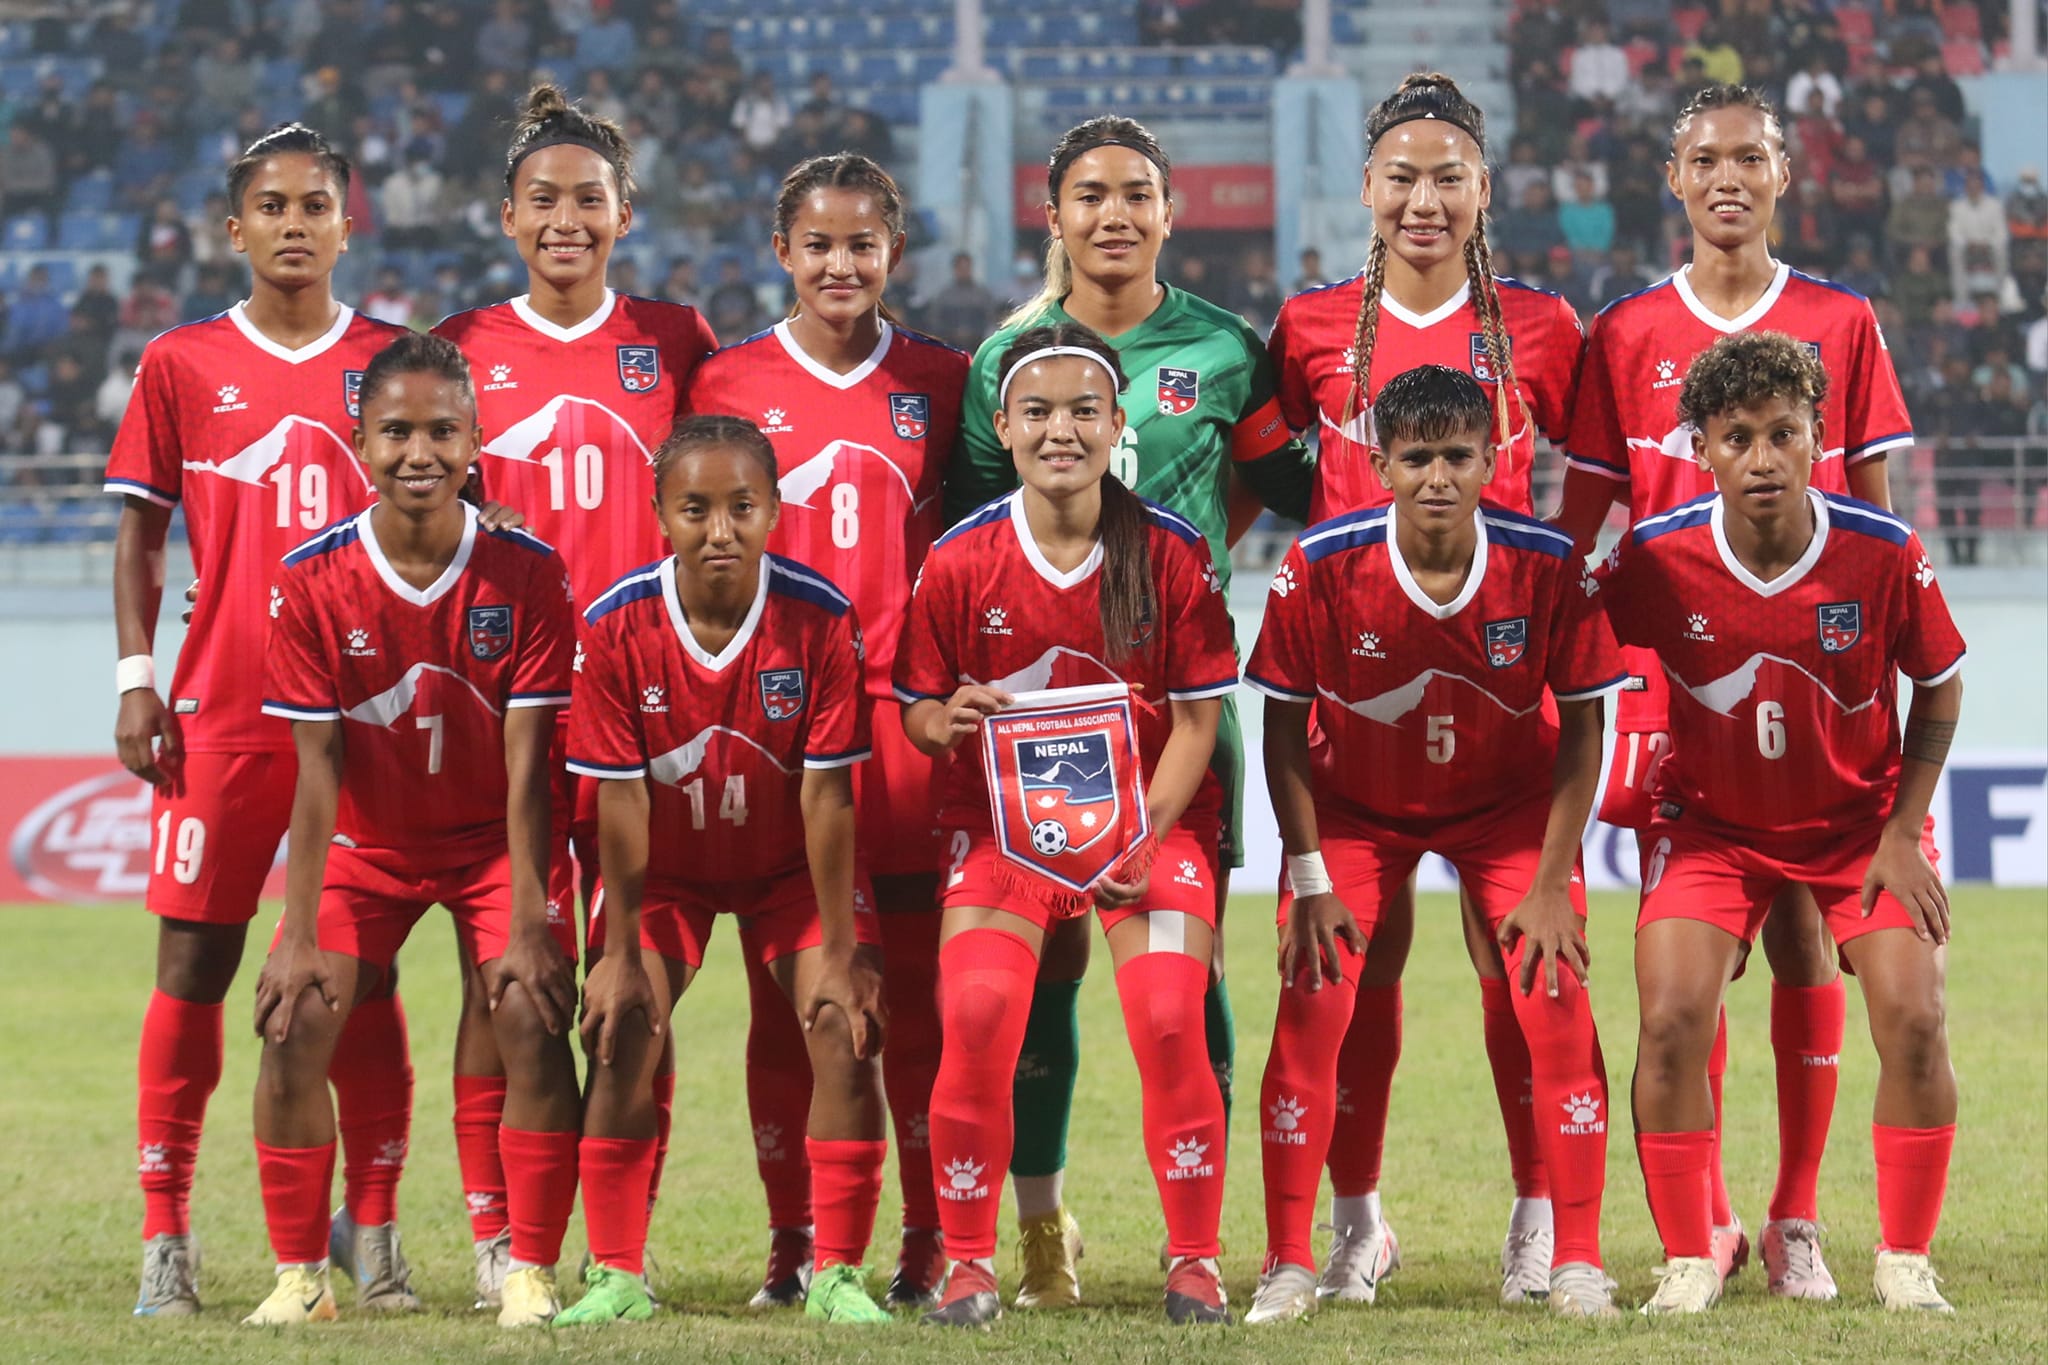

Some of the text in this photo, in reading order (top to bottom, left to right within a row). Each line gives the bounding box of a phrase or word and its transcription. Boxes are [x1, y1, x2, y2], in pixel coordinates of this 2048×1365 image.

[1168, 370, 1188, 378] NEPAL
[483, 382, 518, 391] KELME
[1652, 378, 1683, 389] KELME
[213, 402, 248, 413] KELME
[1259, 415, 1284, 438] CAPT
[541, 444, 604, 511] 10
[269, 463, 328, 530] 19
[831, 482, 859, 549] 8
[980, 627, 1013, 635] KELME
[1683, 631, 1715, 642] KELME
[342, 648, 376, 656] KELME
[1352, 648, 1386, 659] KELME
[997, 711, 1122, 734] ALL NEPAL FOOTBALL ASSOCIATION
[1755, 701, 1787, 760] 6
[416, 714, 443, 774] 7
[1426, 715, 1455, 764] 5
[1034, 741, 1090, 758] NEPAL
[682, 774, 748, 830] 14
[155, 810, 206, 884] 19
[1644, 836, 1672, 893] 6
[1174, 876, 1203, 889] KELME
[1560, 1121, 1604, 1134] KELME
[1264, 1130, 1306, 1145] KELME
[1166, 1165, 1213, 1181] KELME
[940, 1185, 988, 1200] KELME
